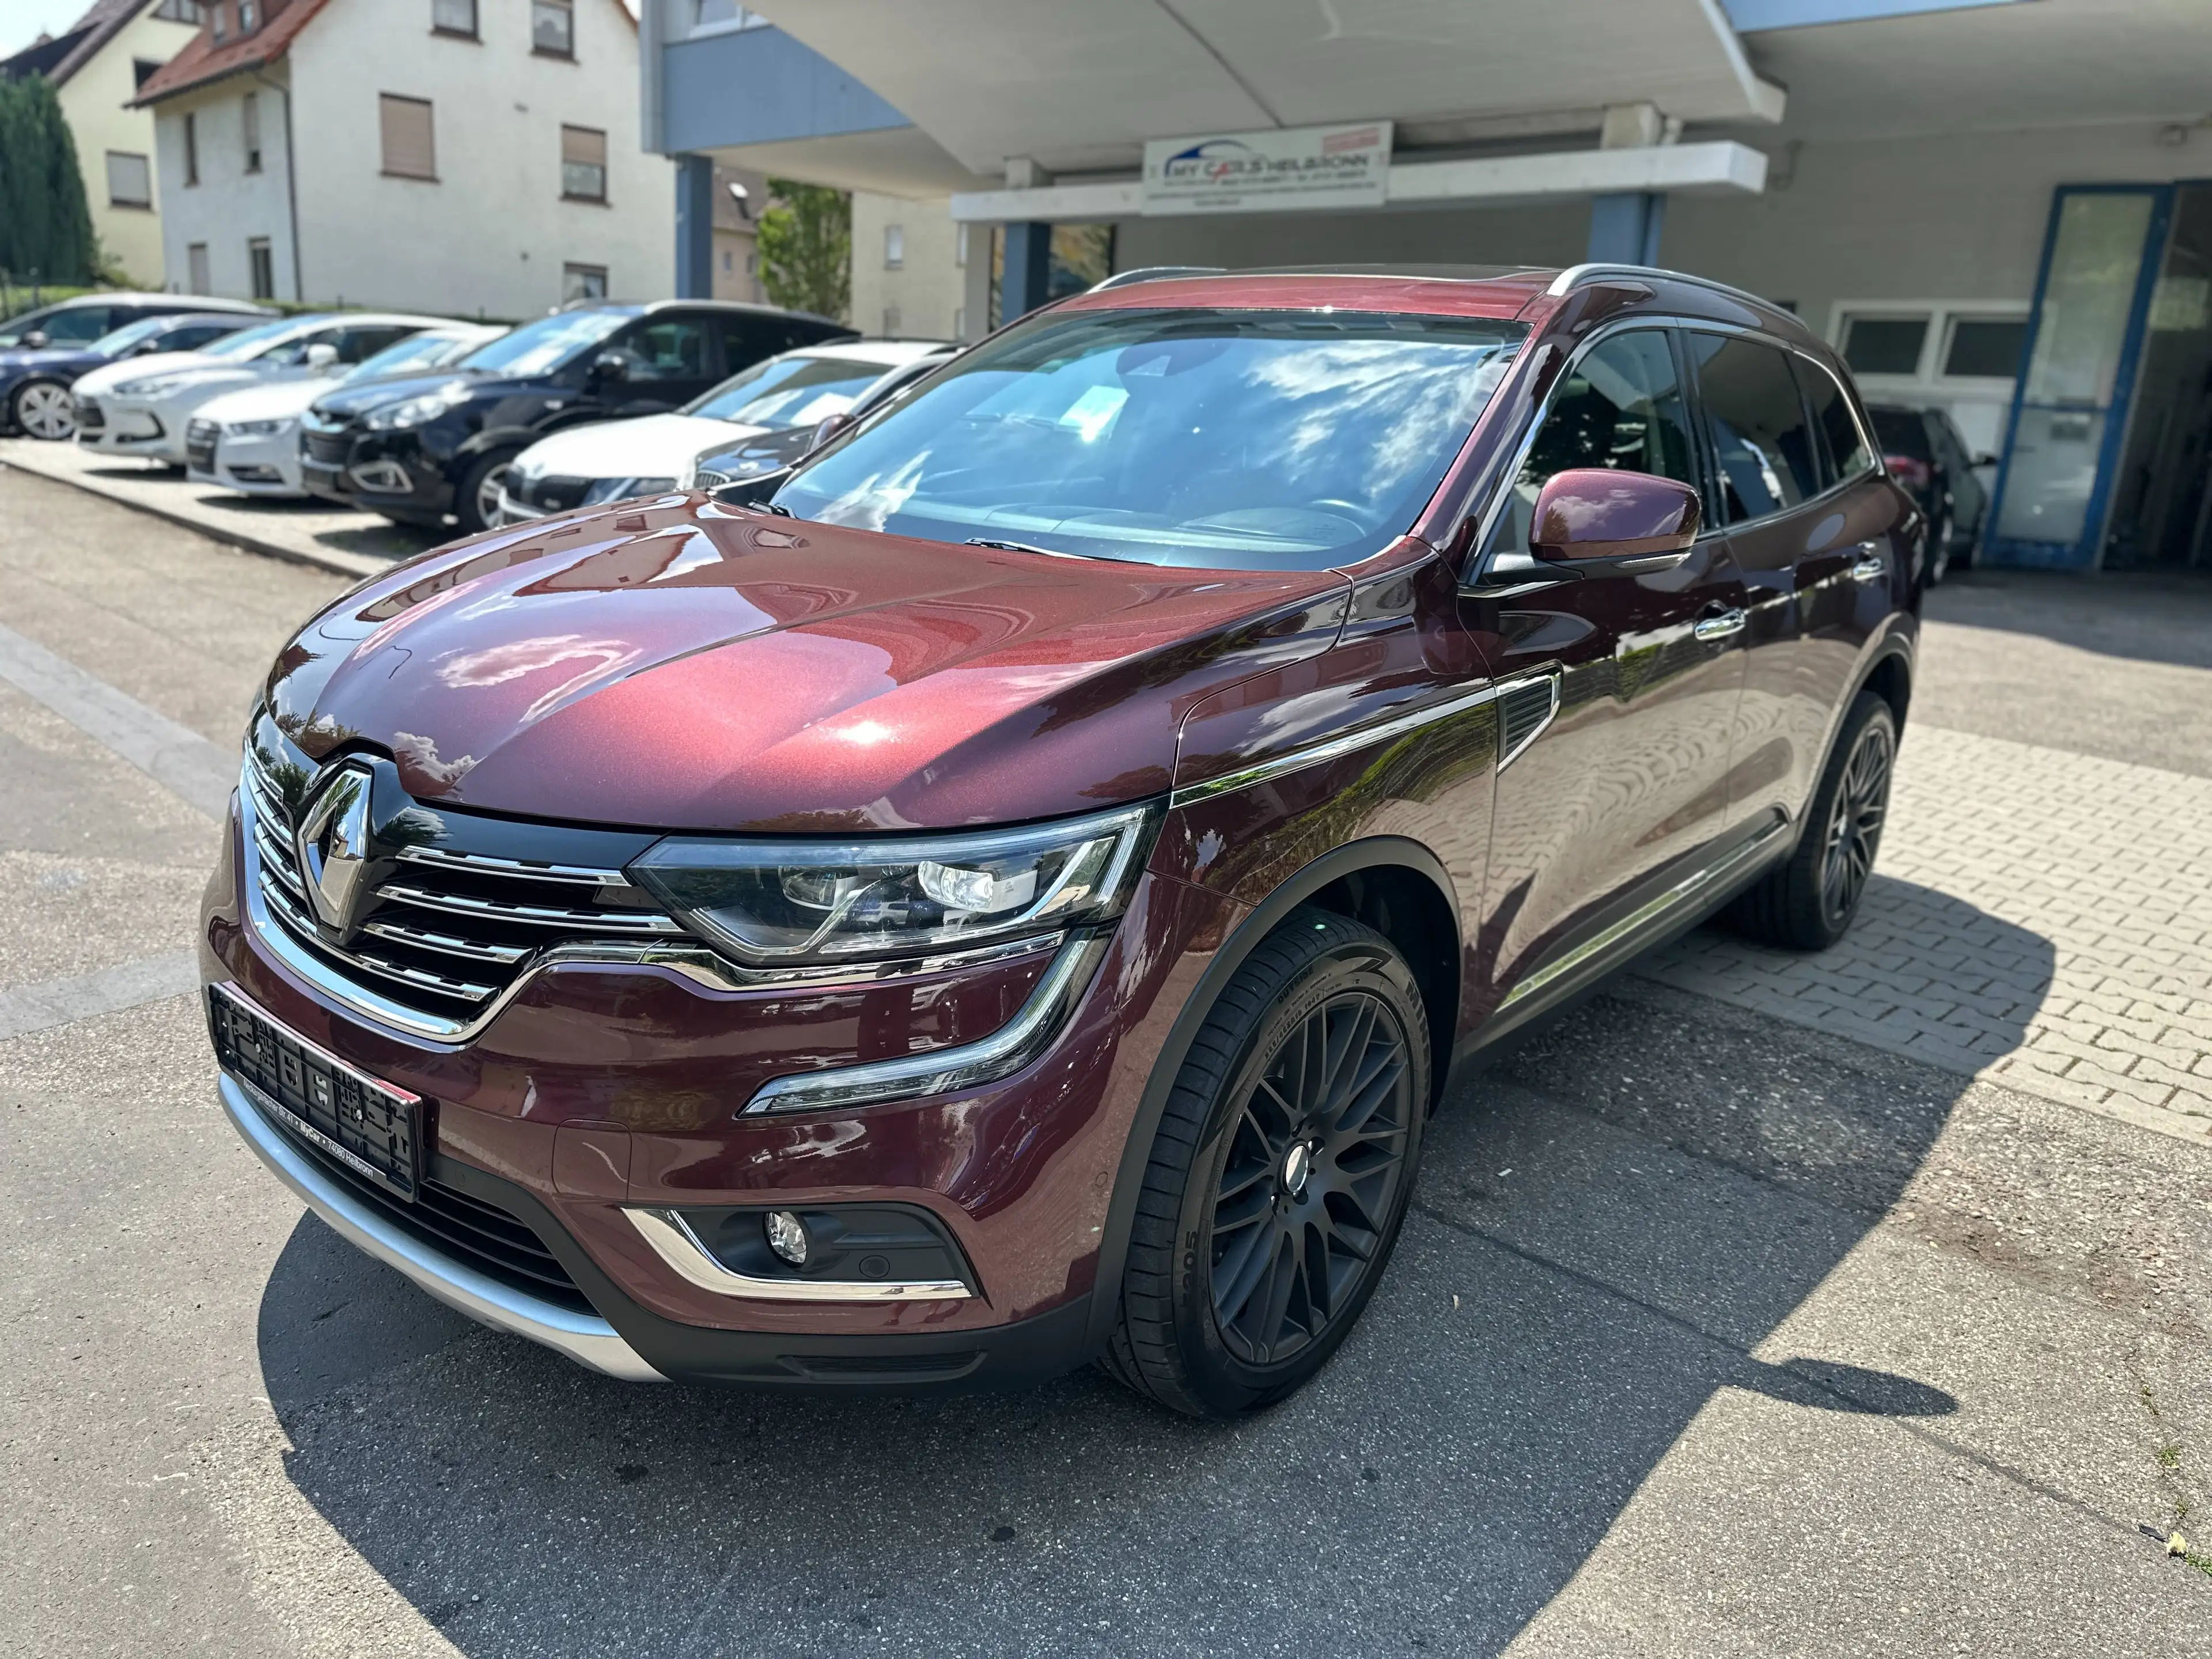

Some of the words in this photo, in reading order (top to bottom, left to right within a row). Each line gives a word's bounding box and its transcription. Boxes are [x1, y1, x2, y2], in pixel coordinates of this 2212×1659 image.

[287, 1113, 293, 1124] 41
[300, 1122, 320, 1142] MyCar
[346, 1152, 373, 1177] Heilbronn
